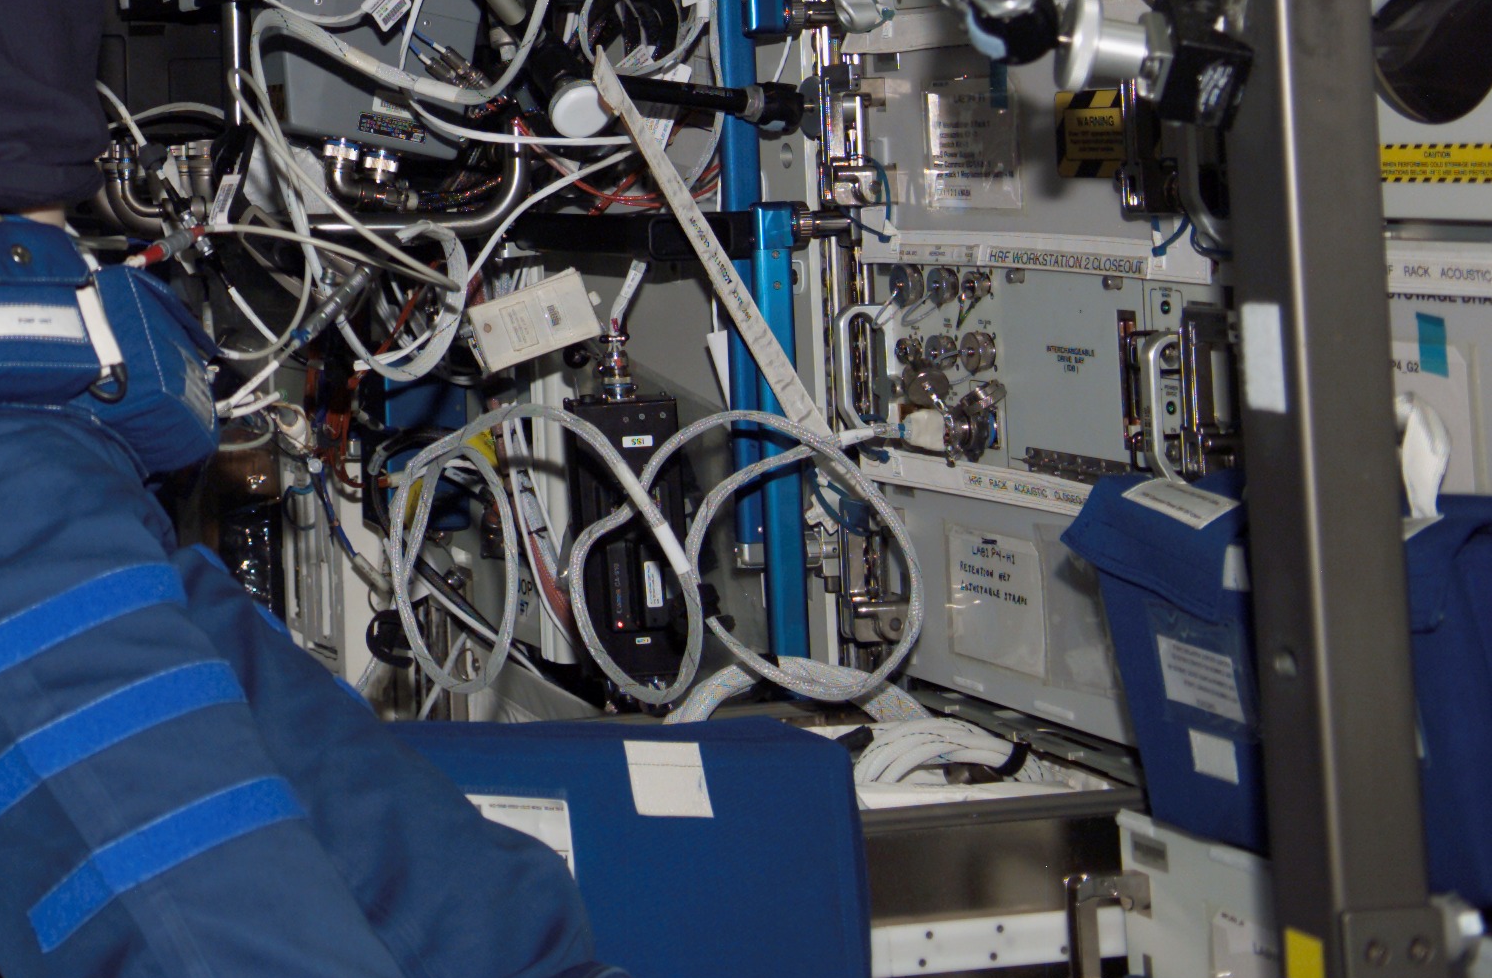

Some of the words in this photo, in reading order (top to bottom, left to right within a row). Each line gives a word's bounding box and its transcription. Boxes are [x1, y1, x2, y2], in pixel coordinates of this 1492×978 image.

[1076, 115, 1115, 127] WARNING
[989, 251, 1010, 264] HRF
[1012, 252, 1082, 269] WORKSTATION
[1084, 257, 1091, 269] 2
[1092, 258, 1144, 274] CLOSEOUT
[1403, 265, 1431, 278] RACK
[1440, 267, 1492, 283] ACOUSTIC
[1046, 345, 1095, 358] INTERCHANGEABLE
[1014, 483, 1048, 500] ACOUSTIC
[959, 560, 994, 578] RETENTION
